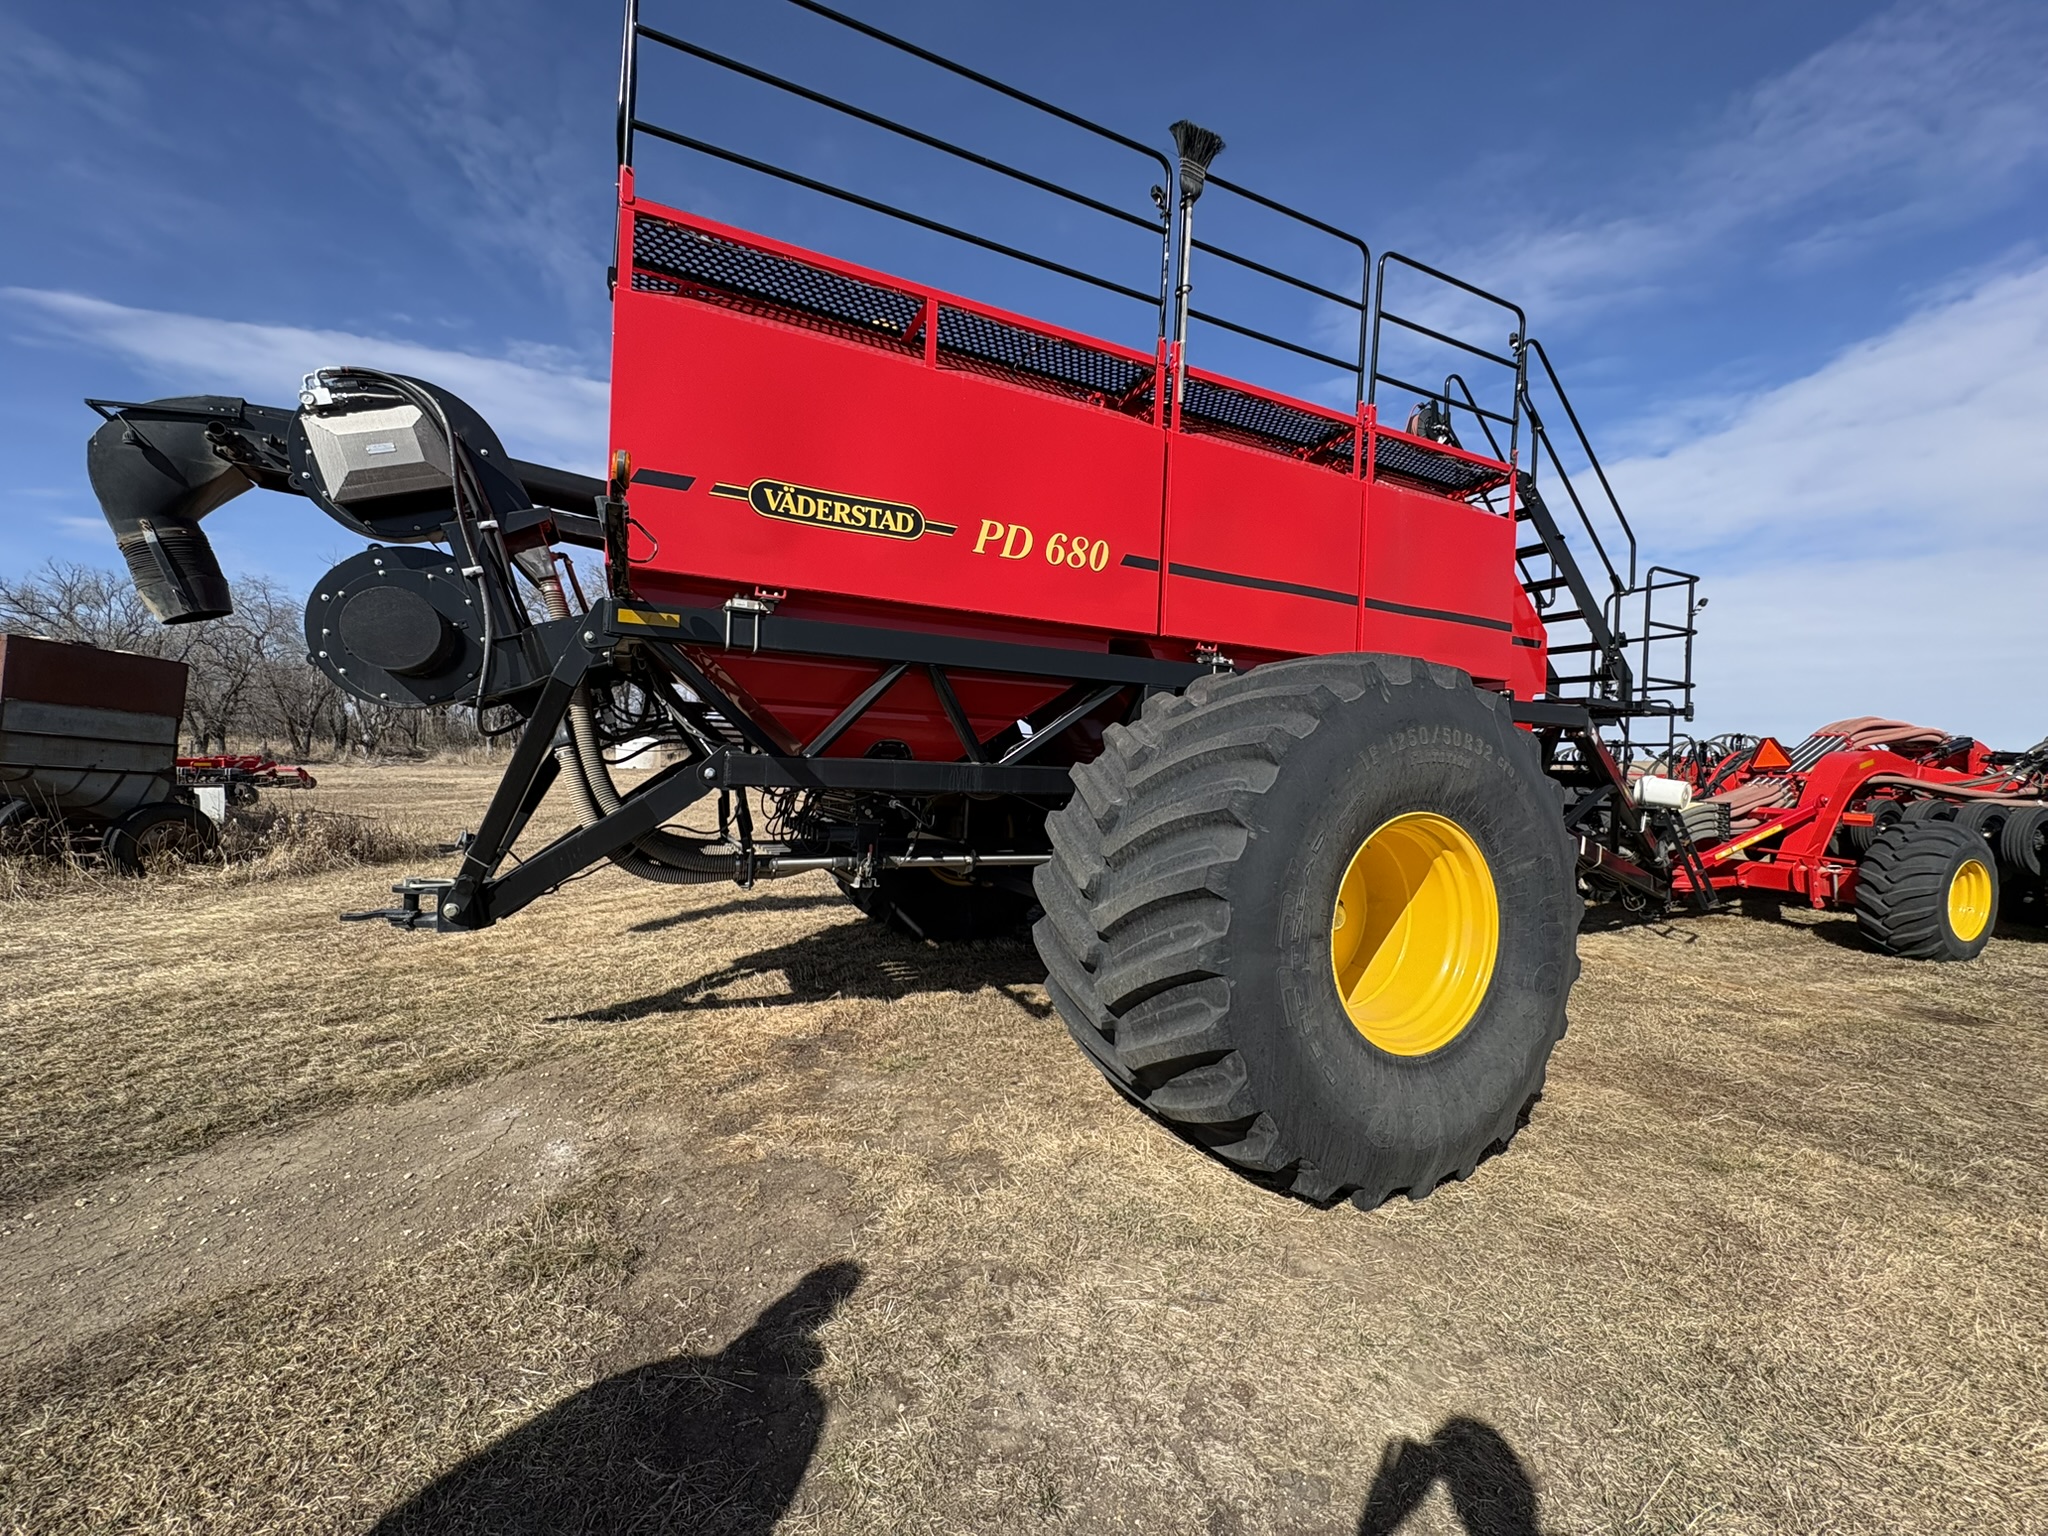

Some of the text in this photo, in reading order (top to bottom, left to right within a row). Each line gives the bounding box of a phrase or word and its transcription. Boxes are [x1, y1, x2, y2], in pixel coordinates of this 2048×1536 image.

[763, 486, 914, 533] VÄDERSTAD
[972, 518, 1110, 572] PD 680
